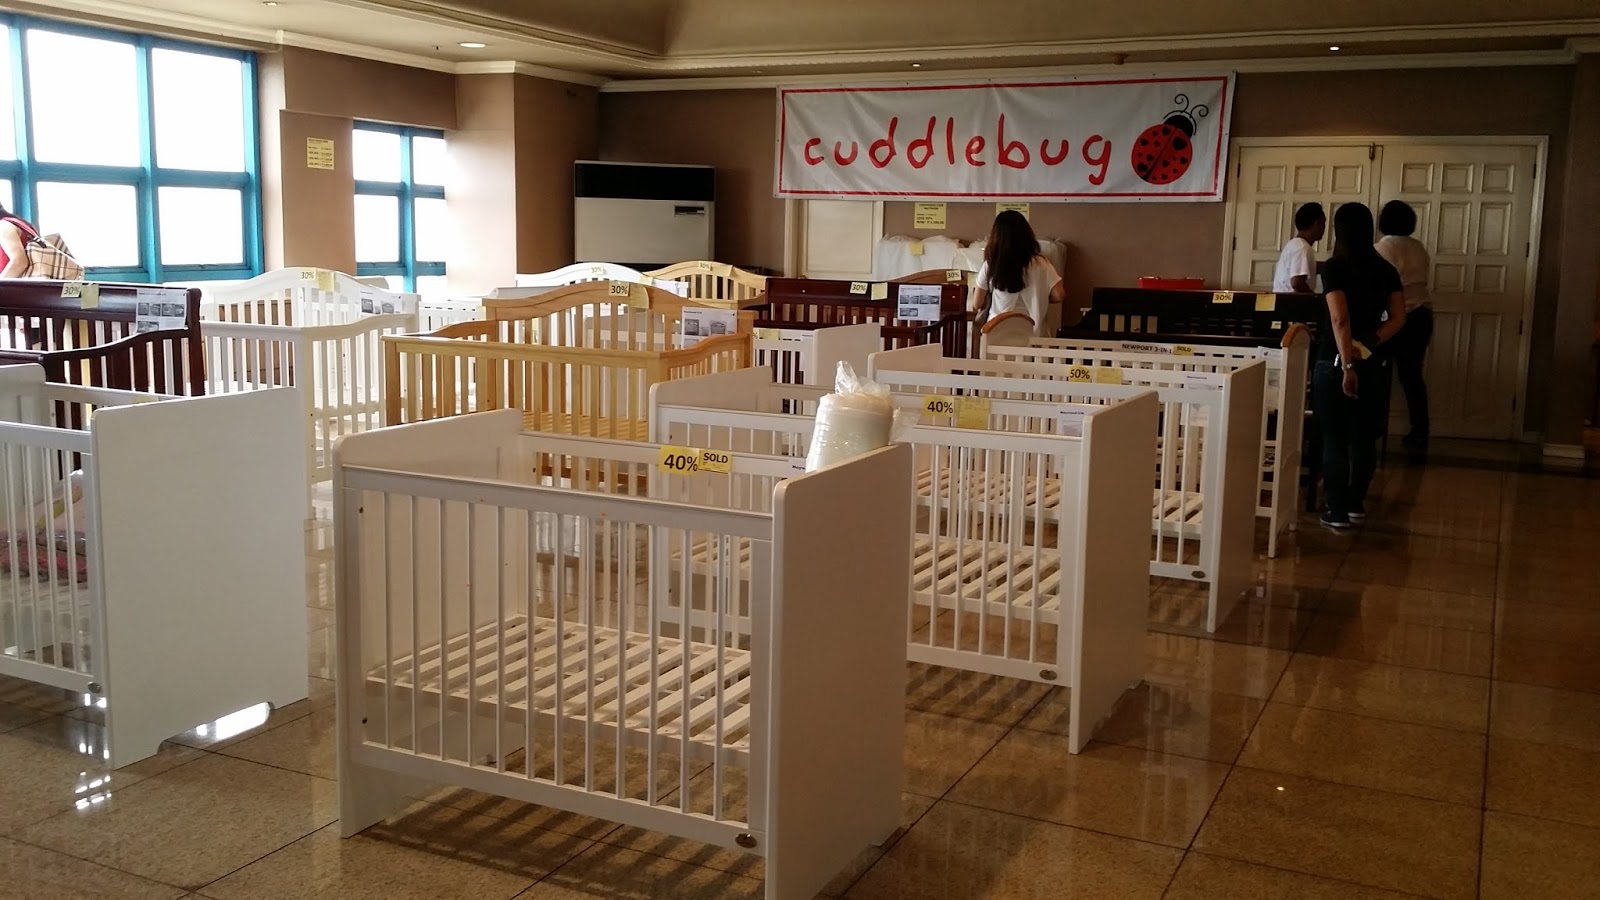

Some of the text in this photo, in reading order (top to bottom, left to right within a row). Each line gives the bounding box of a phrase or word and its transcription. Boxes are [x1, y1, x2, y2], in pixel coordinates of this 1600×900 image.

[804, 113, 1112, 185] cuddlebug
[301, 272, 314, 280] 30%
[947, 271, 960, 279] 30%
[63, 286, 80, 295] 30%
[610, 284, 628, 295] 30%
[852, 283, 866, 291] 30%
[1154, 346, 1172, 354] 3-IN-1
[1069, 368, 1091, 380] 50%
[927, 400, 954, 414] 40%
[663, 454, 698, 472] 40%
[703, 452, 728, 464] SOLD
